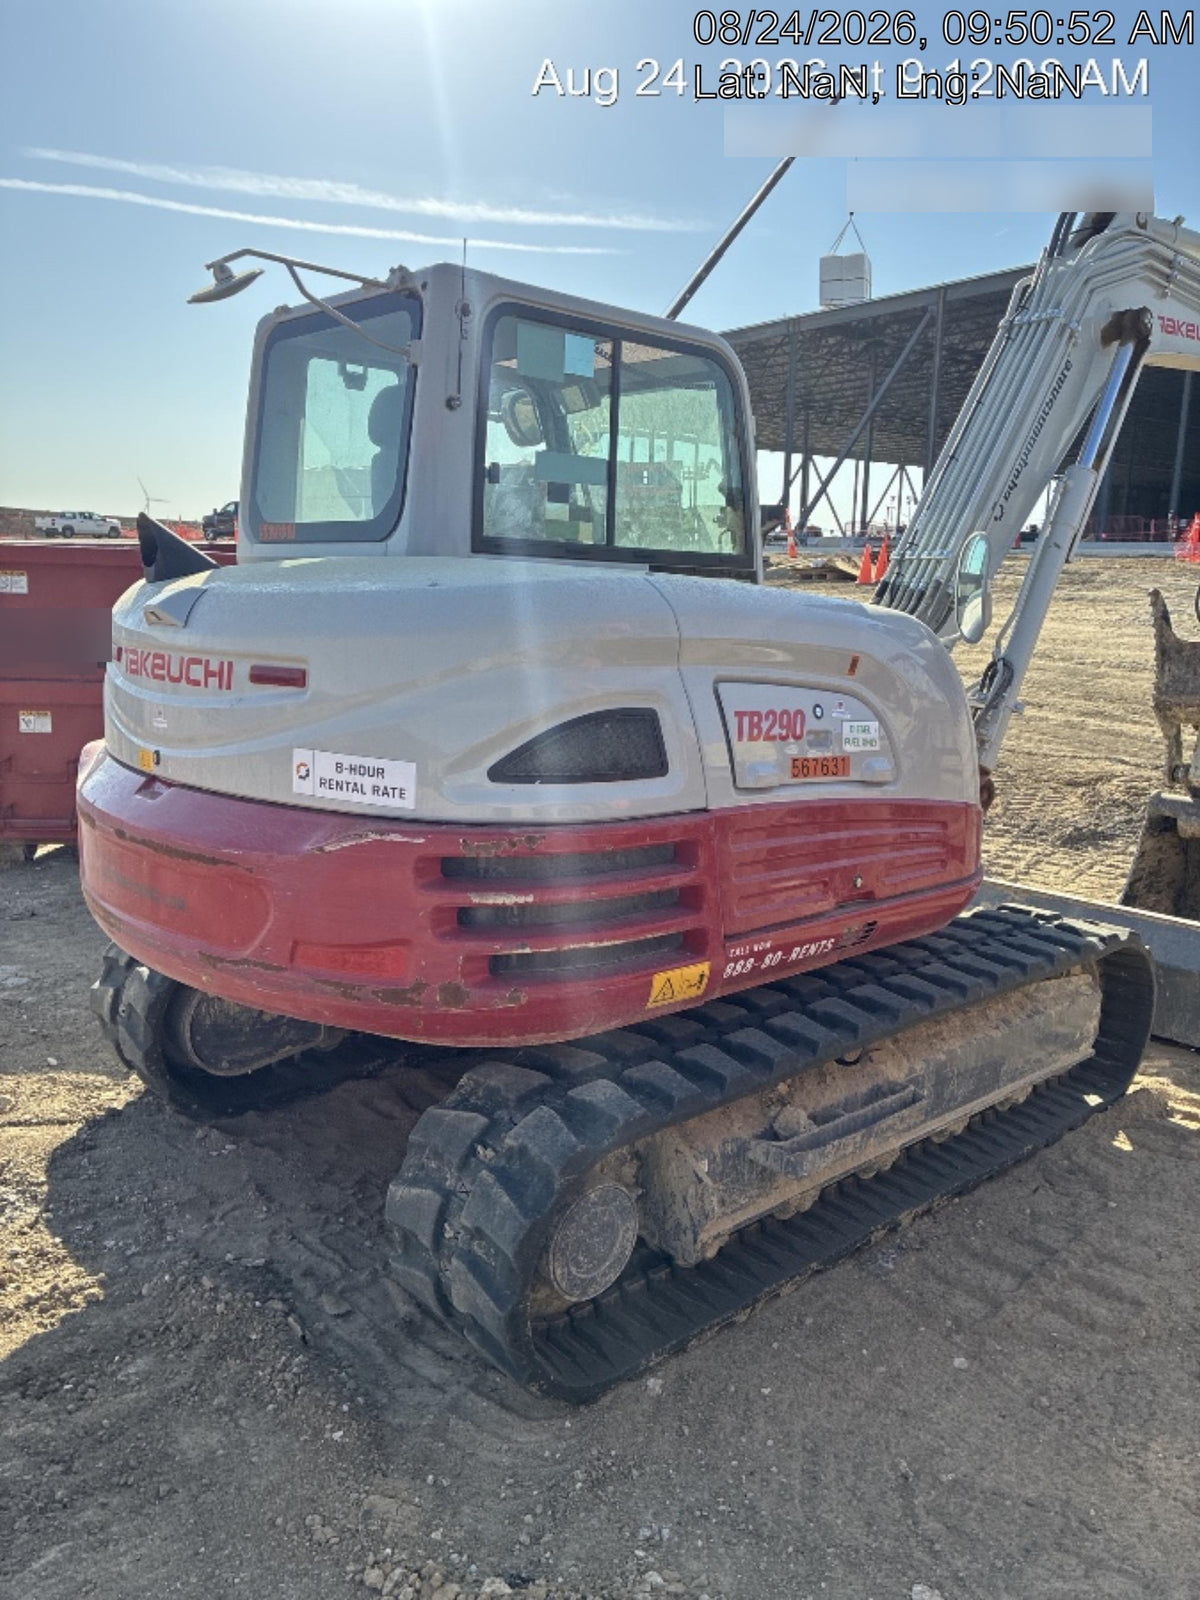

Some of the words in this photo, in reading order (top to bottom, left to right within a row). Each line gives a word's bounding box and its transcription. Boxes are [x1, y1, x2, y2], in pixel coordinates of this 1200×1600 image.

[124, 646, 234, 691] TAKEUCHI
[734, 709, 806, 742] TB290
[335, 762, 385, 780] 8-HOUR
[792, 757, 847, 778] 567631
[319, 777, 367, 796] RENTAL
[372, 785, 407, 800] RATE
[723, 938, 835, 979] 888-80-RENTS
